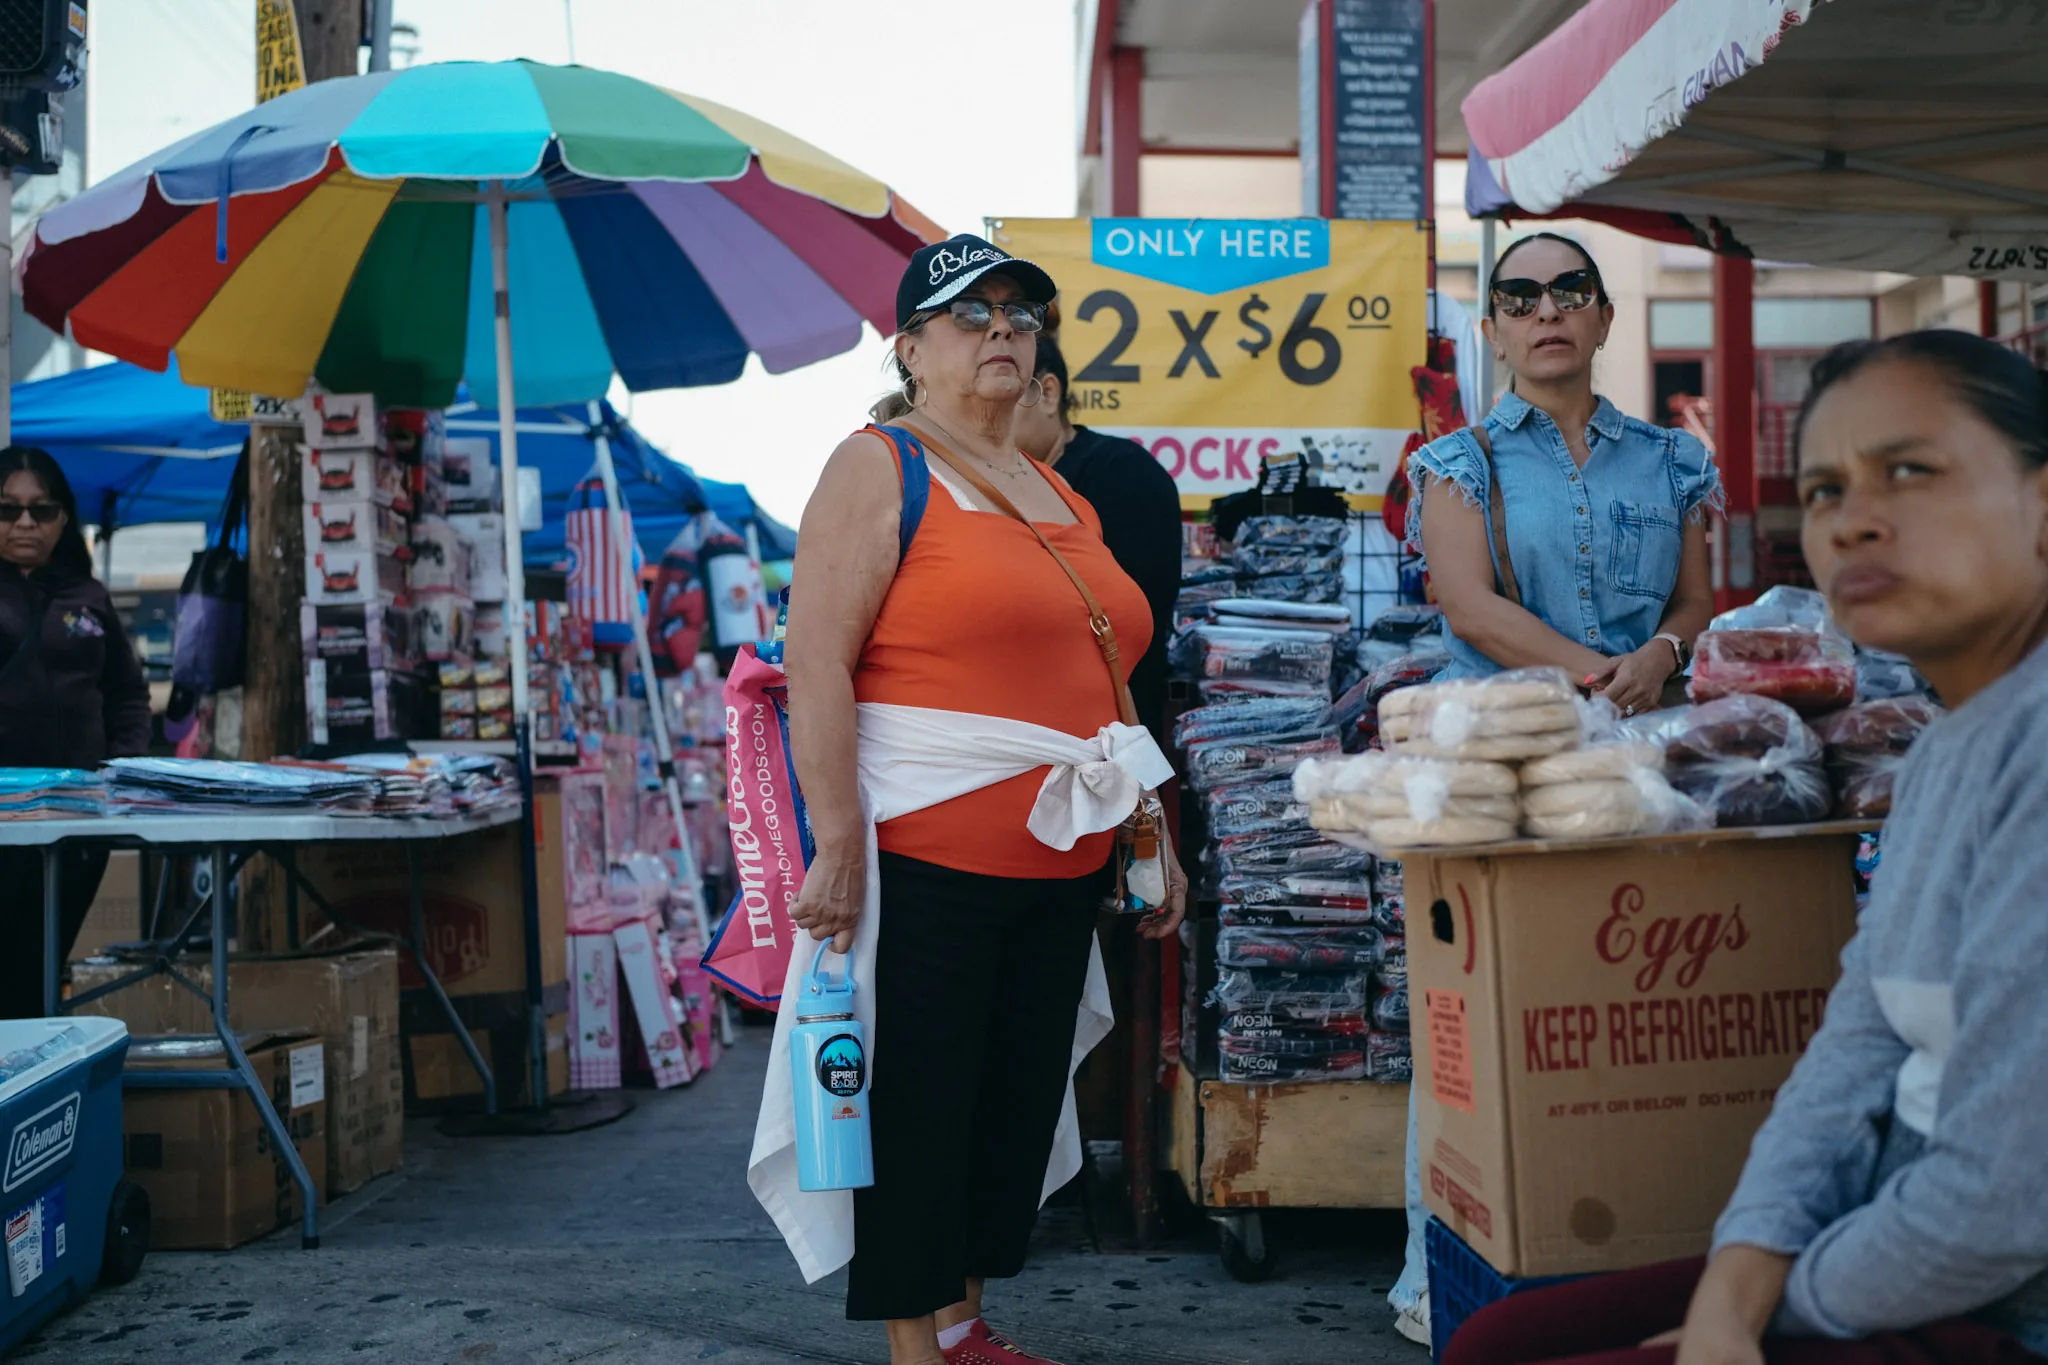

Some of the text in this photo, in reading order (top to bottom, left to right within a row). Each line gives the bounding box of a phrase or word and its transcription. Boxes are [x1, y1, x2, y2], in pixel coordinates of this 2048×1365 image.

[1106, 228, 1311, 258] ONLY HERE
[1055, 289, 1140, 383] 2
[1166, 310, 1221, 378] X
[1067, 389, 1121, 410] AIRS
[1129, 435, 1281, 481] OCKS
[751, 702, 796, 886] HOMEGOODS.COM
[1226, 799, 1267, 818] NEON
[1595, 882, 1750, 993] Eggs
[1233, 1014, 1273, 1028] NEON
[1523, 1004, 1597, 1073] KEEP
[1238, 1056, 1278, 1071] NEON
[1388, 1056, 1415, 1070] NEO
[830, 1070, 859, 1080] SPIRIT
[1548, 1105, 1566, 1118] AT
[1634, 1096, 1687, 1112] BELOW
[1699, 1093, 1722, 1107] DO
[1726, 1091, 1756, 1105] NOT
[15, 1120, 63, 1168] Coleman
